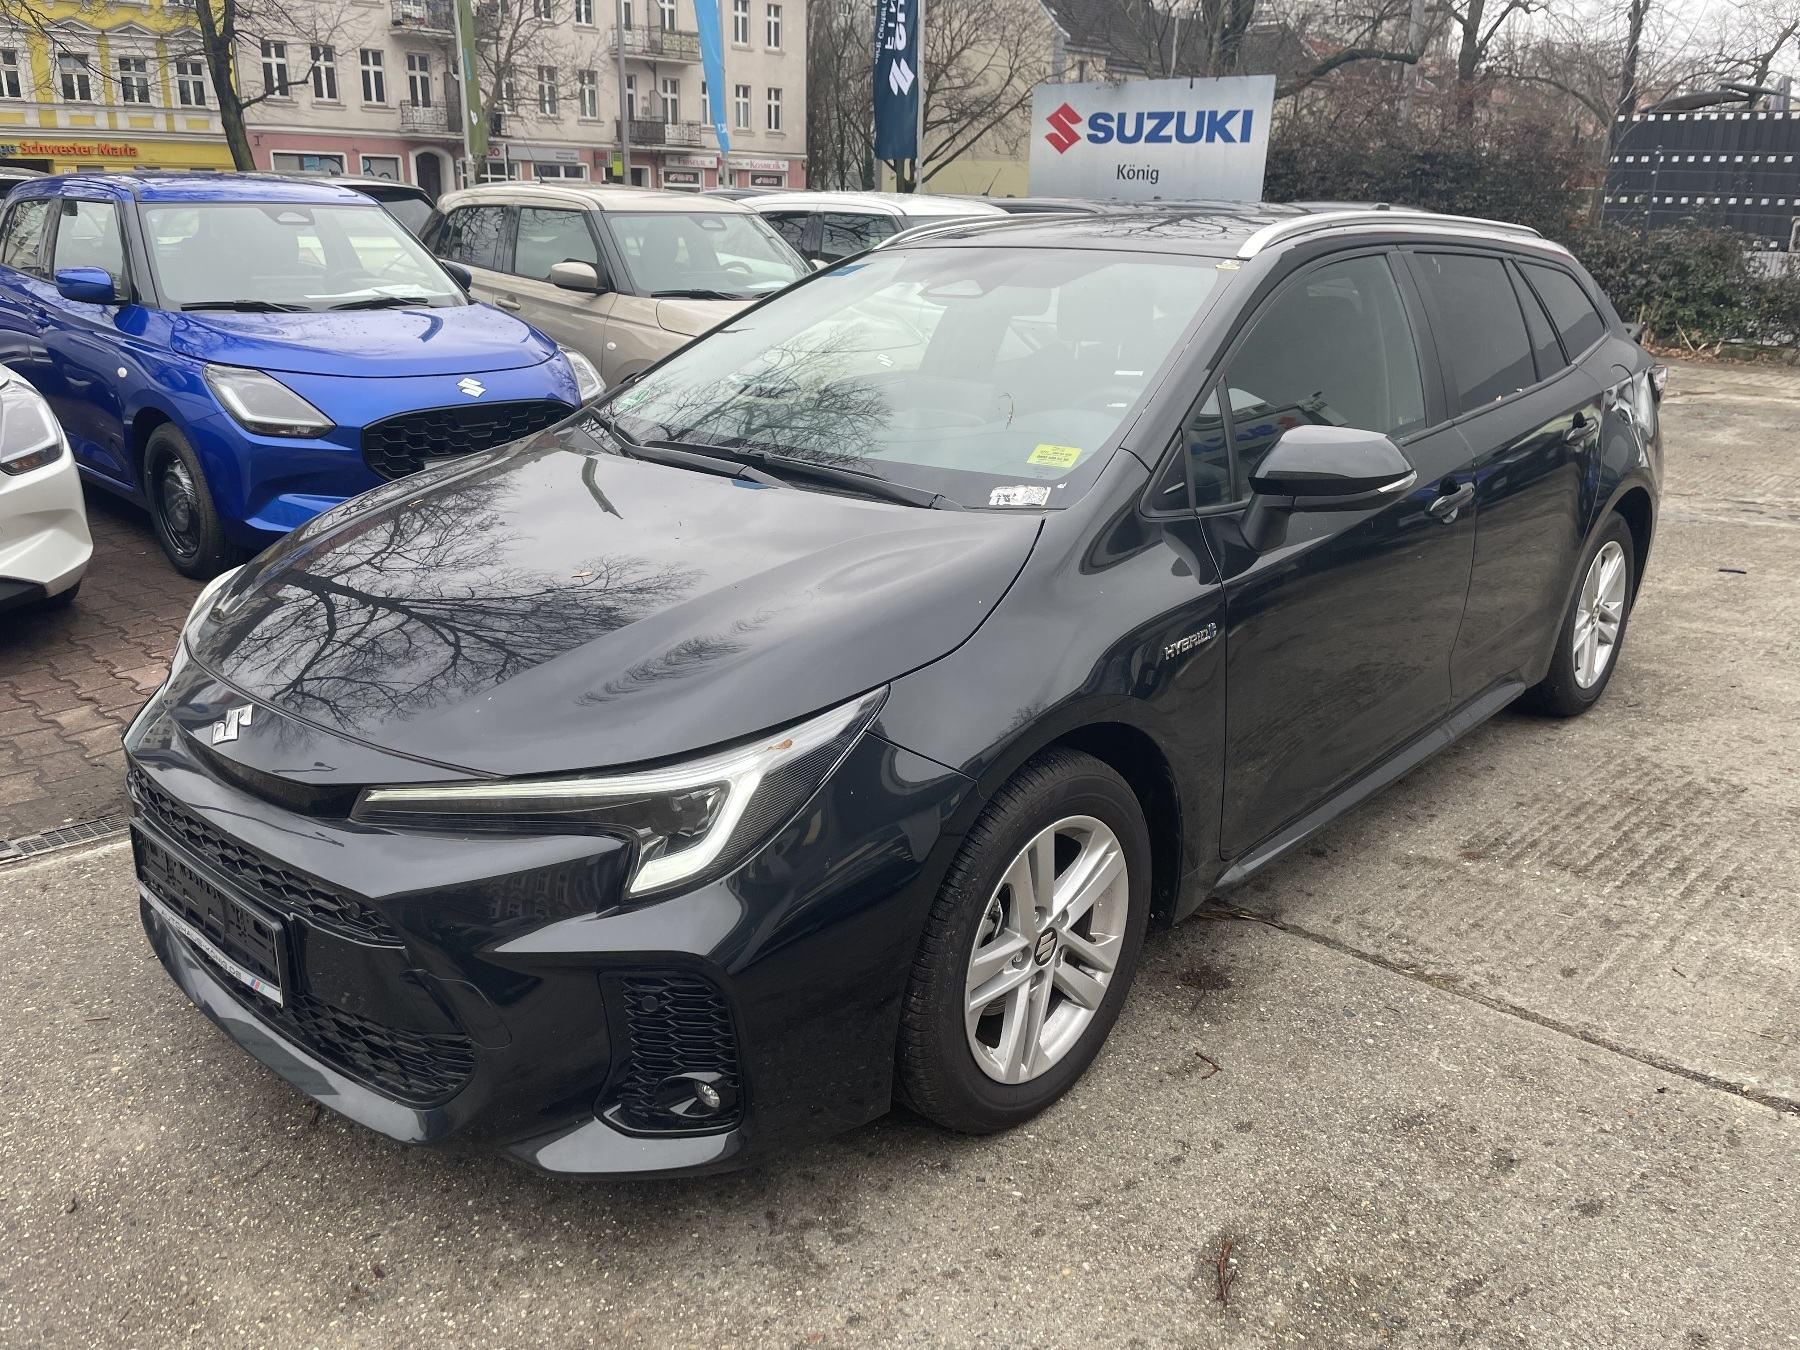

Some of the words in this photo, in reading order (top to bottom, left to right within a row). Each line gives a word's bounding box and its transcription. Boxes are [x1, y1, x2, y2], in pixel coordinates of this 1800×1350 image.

[1086, 109, 1254, 144] SUZUKI
[20, 140, 92, 156] Schwester
[99, 142, 137, 157] Maria
[1116, 164, 1160, 185] König
[1164, 628, 1211, 661] HYBRID
